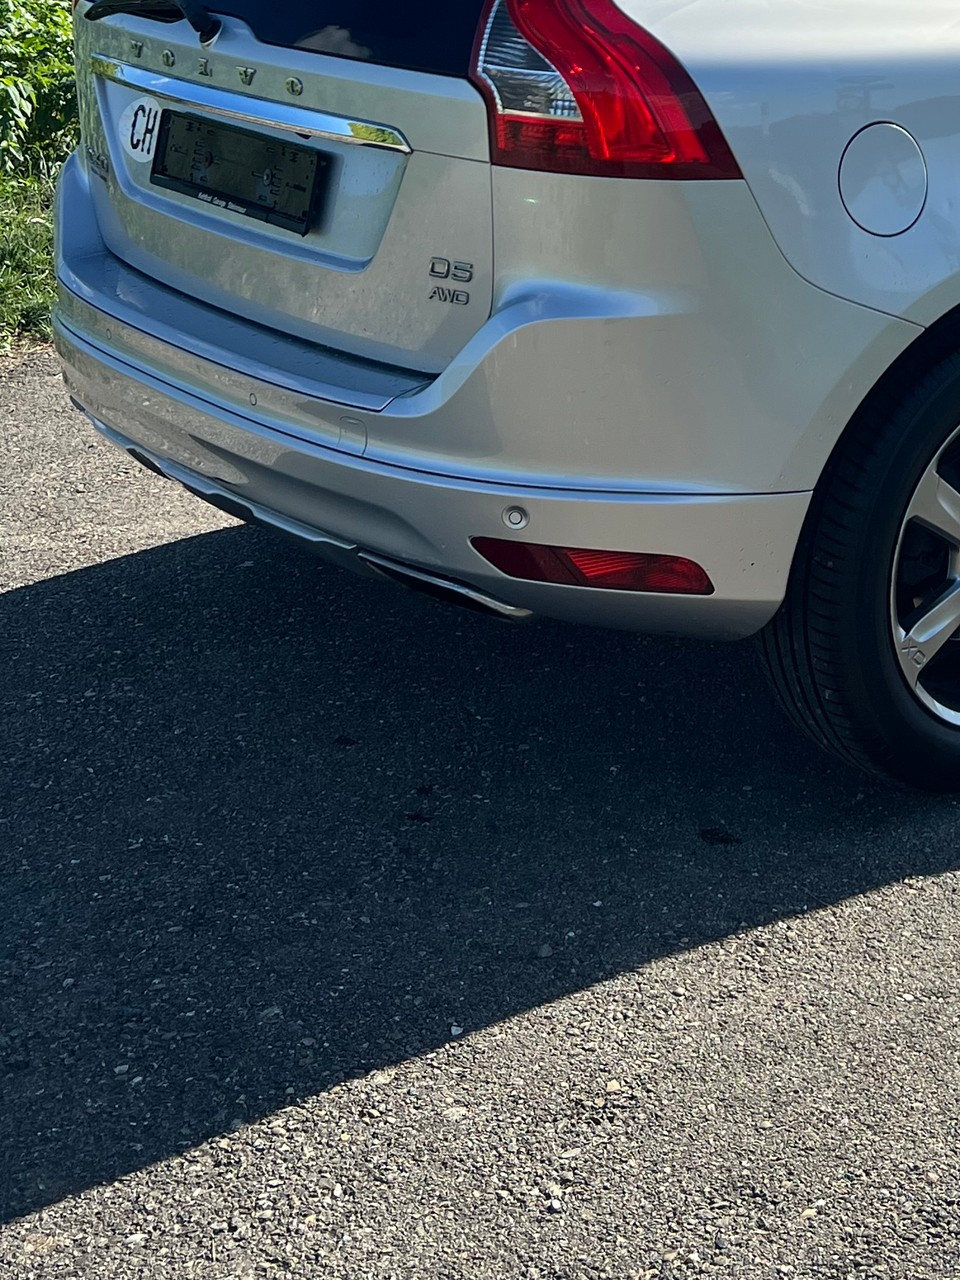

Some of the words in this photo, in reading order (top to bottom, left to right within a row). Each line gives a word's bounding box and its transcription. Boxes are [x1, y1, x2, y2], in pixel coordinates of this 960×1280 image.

[130, 39, 304, 97] VOLVO
[131, 105, 158, 155] CH
[428, 256, 474, 283] D5
[428, 286, 470, 306] AWD
